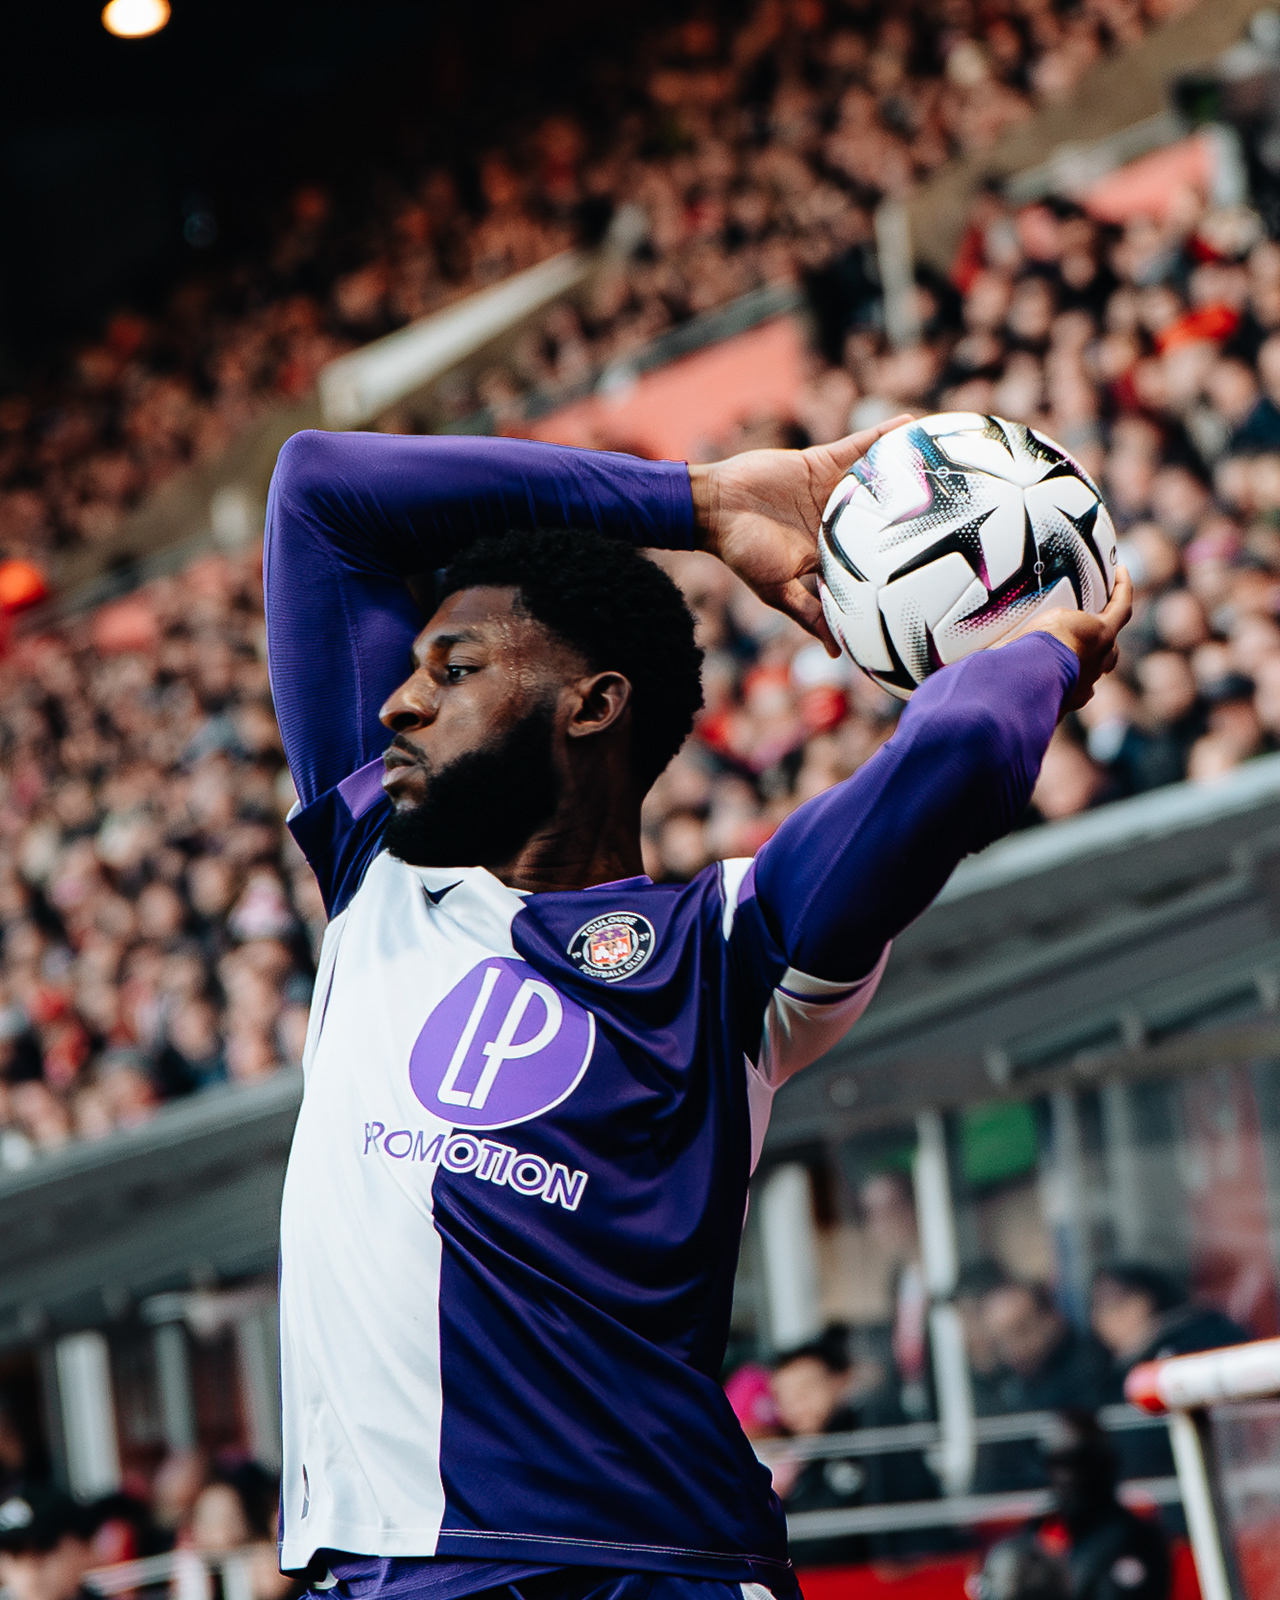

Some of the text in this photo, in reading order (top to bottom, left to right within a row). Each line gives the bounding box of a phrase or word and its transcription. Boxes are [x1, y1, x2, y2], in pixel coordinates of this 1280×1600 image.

[581, 916, 637, 937] TOULOUSE
[625, 950, 646, 970] CLUB
[437, 967, 563, 1110] LP
